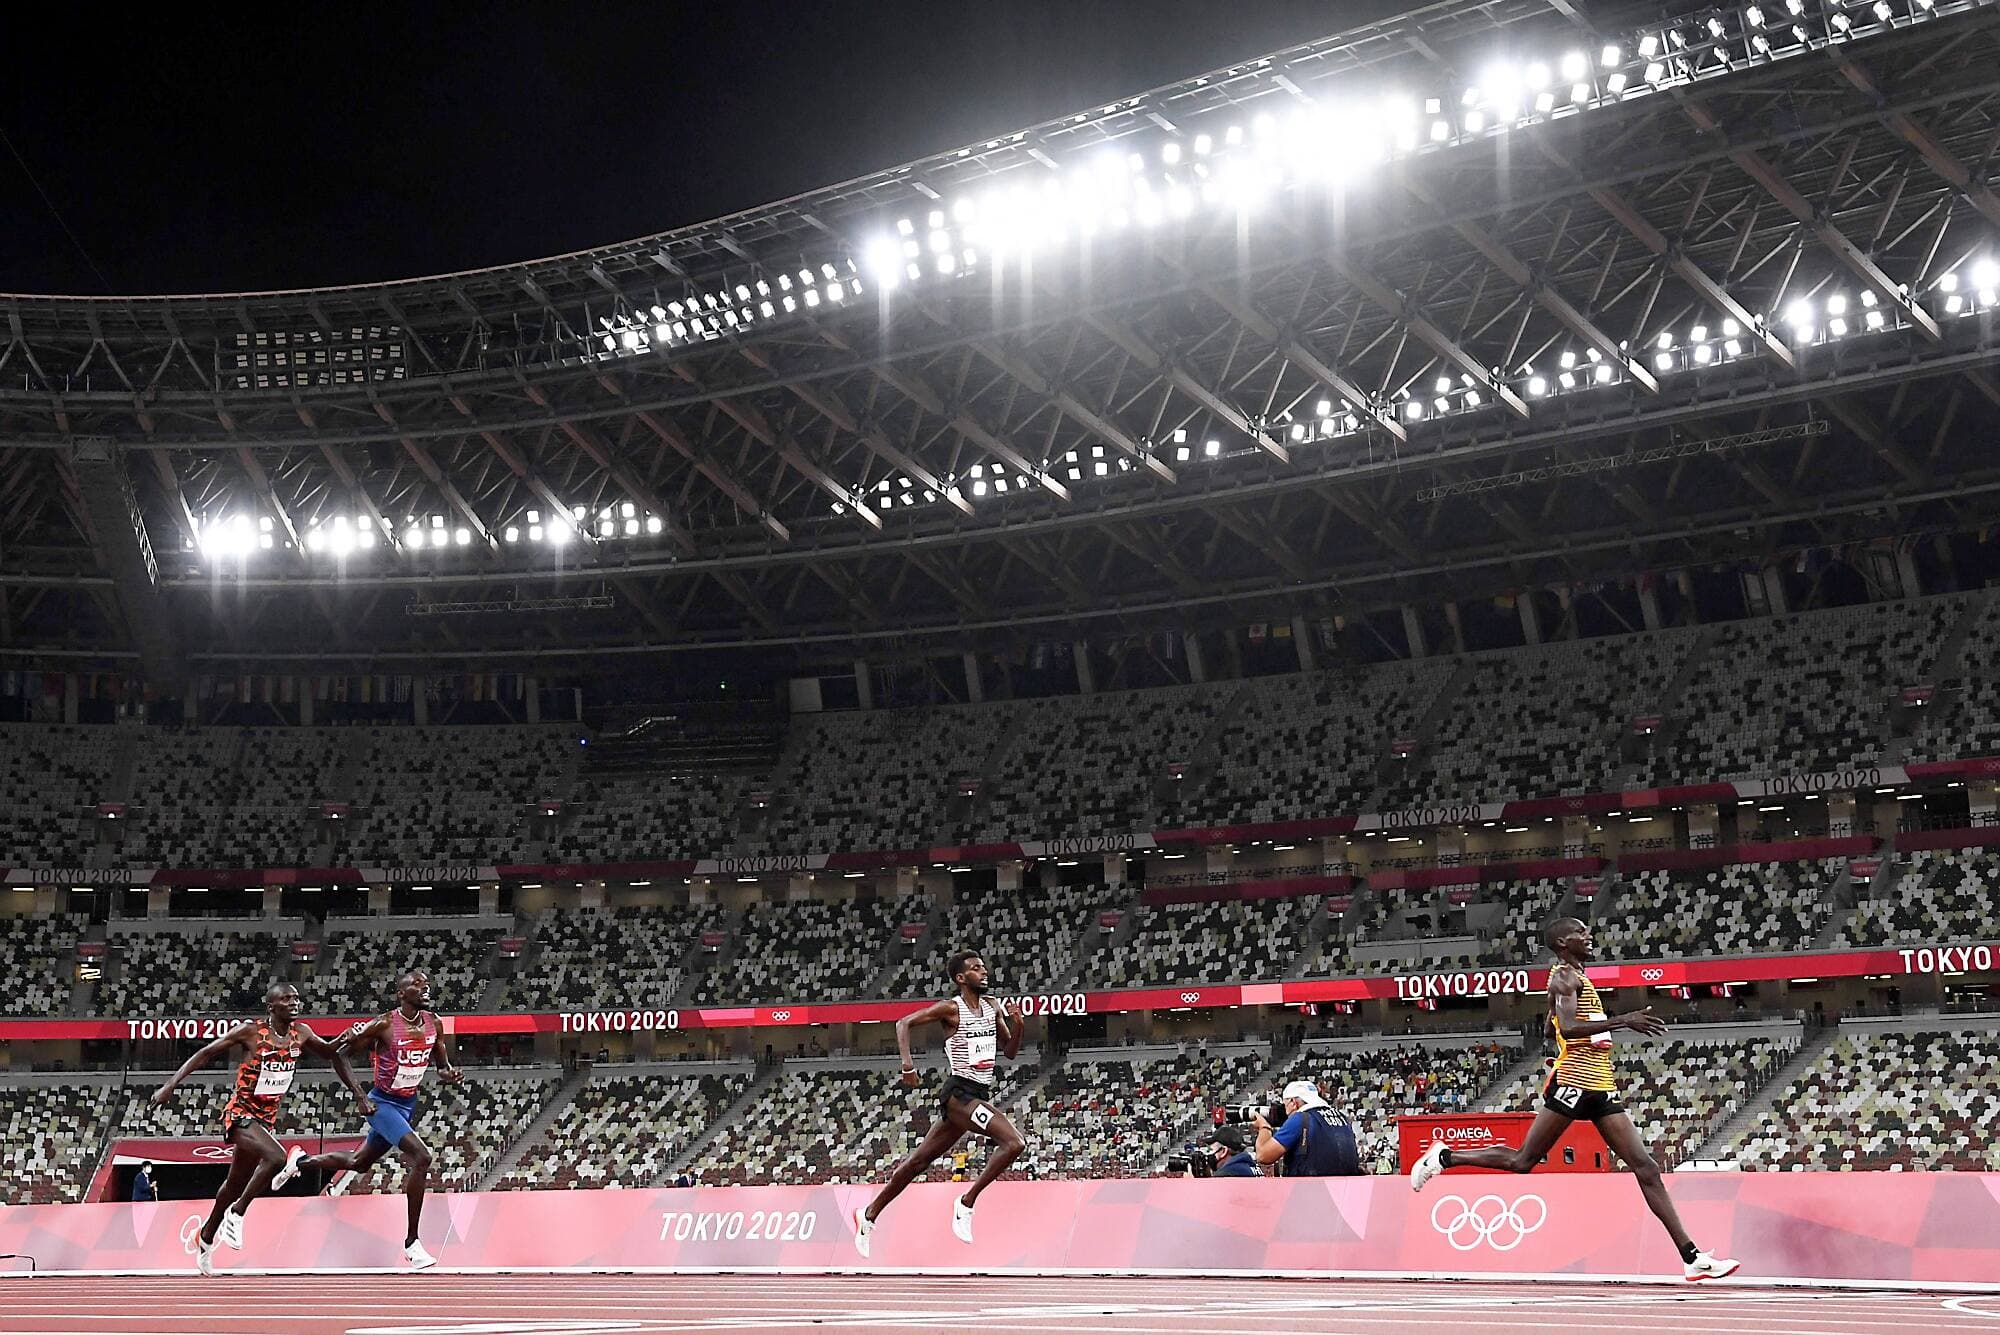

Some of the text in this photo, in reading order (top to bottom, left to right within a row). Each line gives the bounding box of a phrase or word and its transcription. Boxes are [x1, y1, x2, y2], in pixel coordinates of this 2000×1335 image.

[1762, 769, 1881, 795] TOKYO 2020
[1379, 804, 1481, 828] TOKYO 2020
[1043, 834, 1135, 855] TOKYO 2020
[383, 866, 479, 882] TOKYO 2020
[717, 855, 808, 874] TOKYO 2020
[30, 868, 133, 883] TOKYO 2020
[1898, 945, 1992, 974] TOKYO
[1393, 970, 1529, 998] TOKYO 2020
[997, 993, 1086, 1017] KYO 2020
[127, 1019, 254, 1040] TOKYO 20
[559, 1010, 679, 1033] TOKYO 2020
[966, 1030, 996, 1039] CANAD
[397, 1047, 432, 1065] USA
[1561, 1087, 1578, 1105] 12
[976, 1111, 988, 1124] 6
[1446, 1127, 1493, 1139] OMEGA
[660, 1210, 817, 1241] TOKYO 2020
